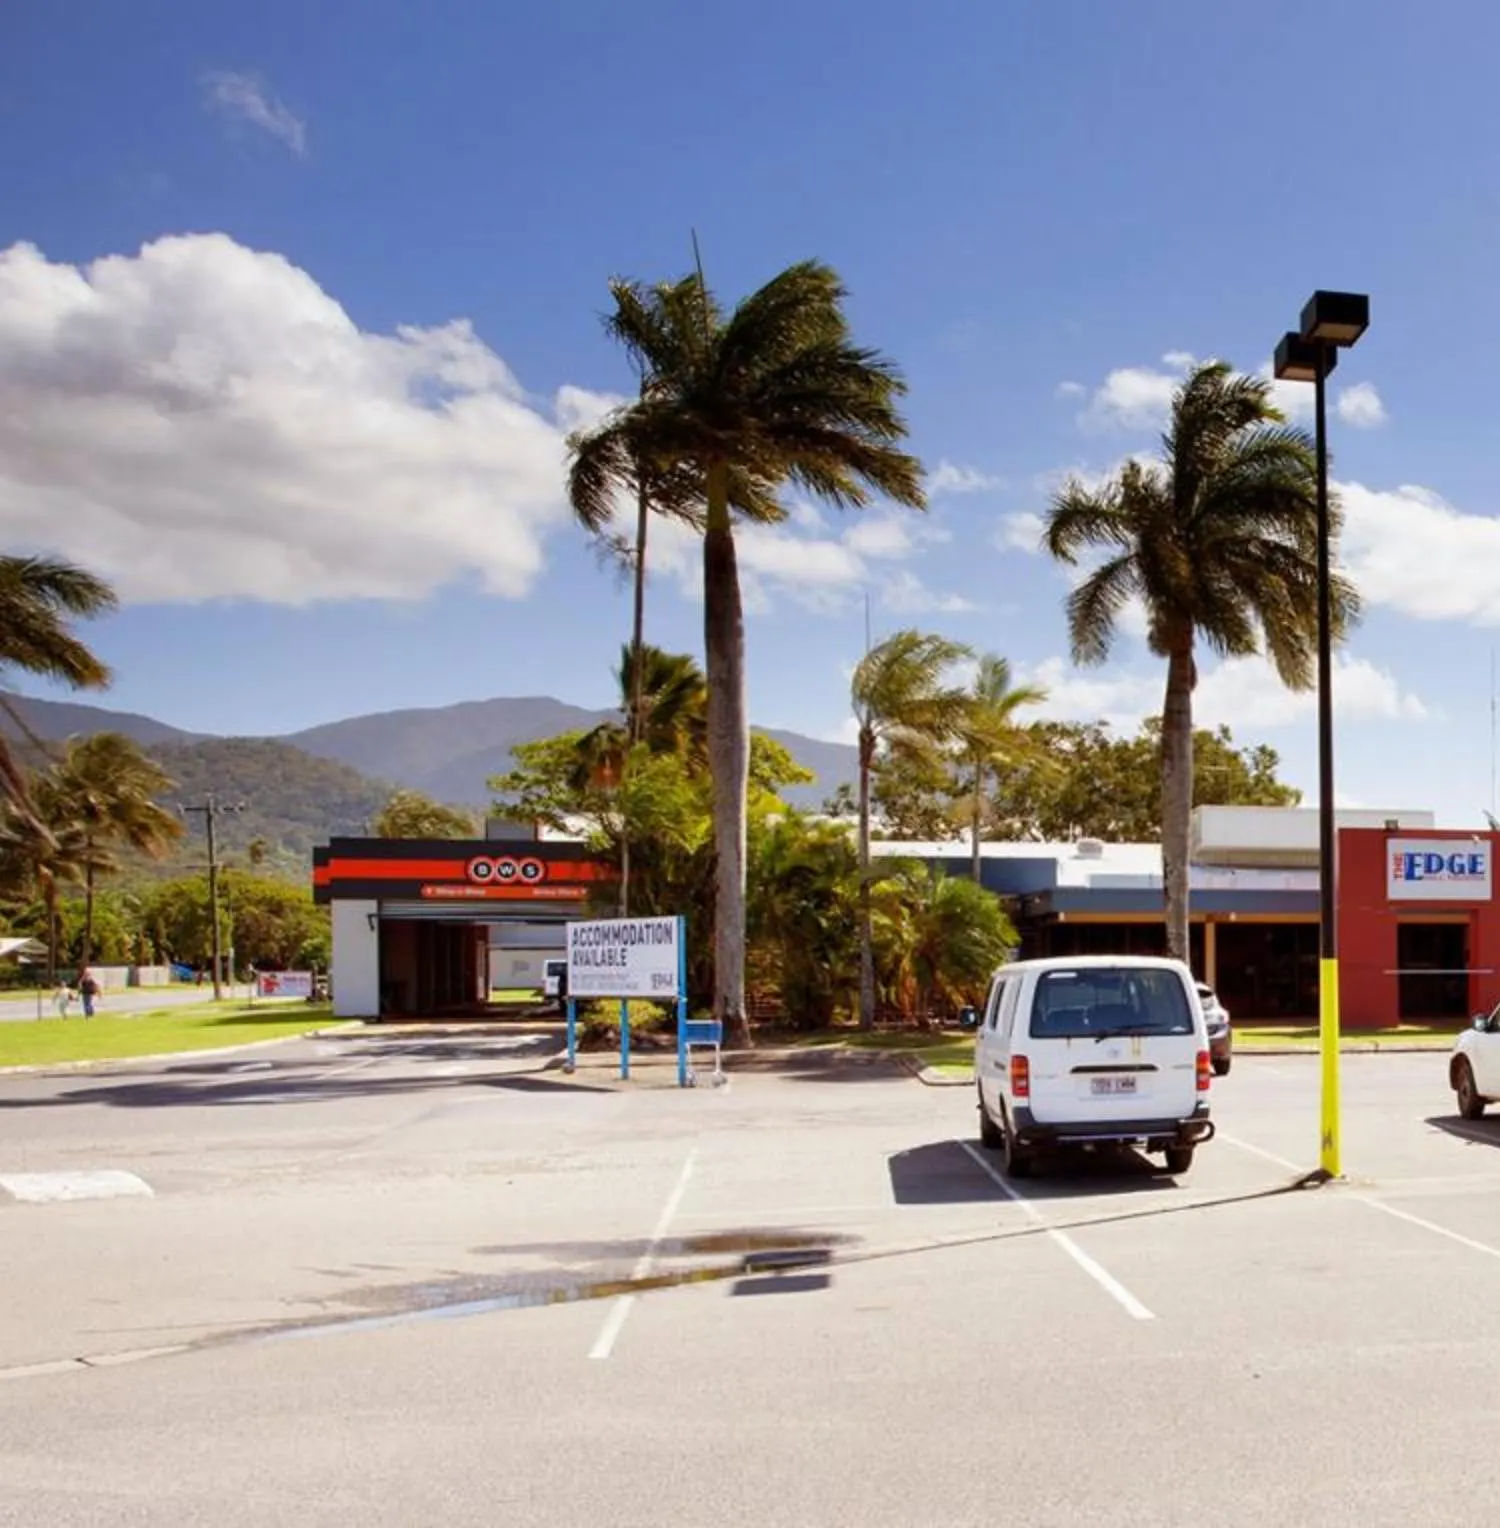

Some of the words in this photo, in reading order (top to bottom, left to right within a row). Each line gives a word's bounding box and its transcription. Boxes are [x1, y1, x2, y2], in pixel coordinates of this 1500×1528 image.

[1404, 851, 1485, 881] EDGE
[572, 922, 673, 946] ACCOMMODATION
[572, 948, 628, 967] AVAILABLE
